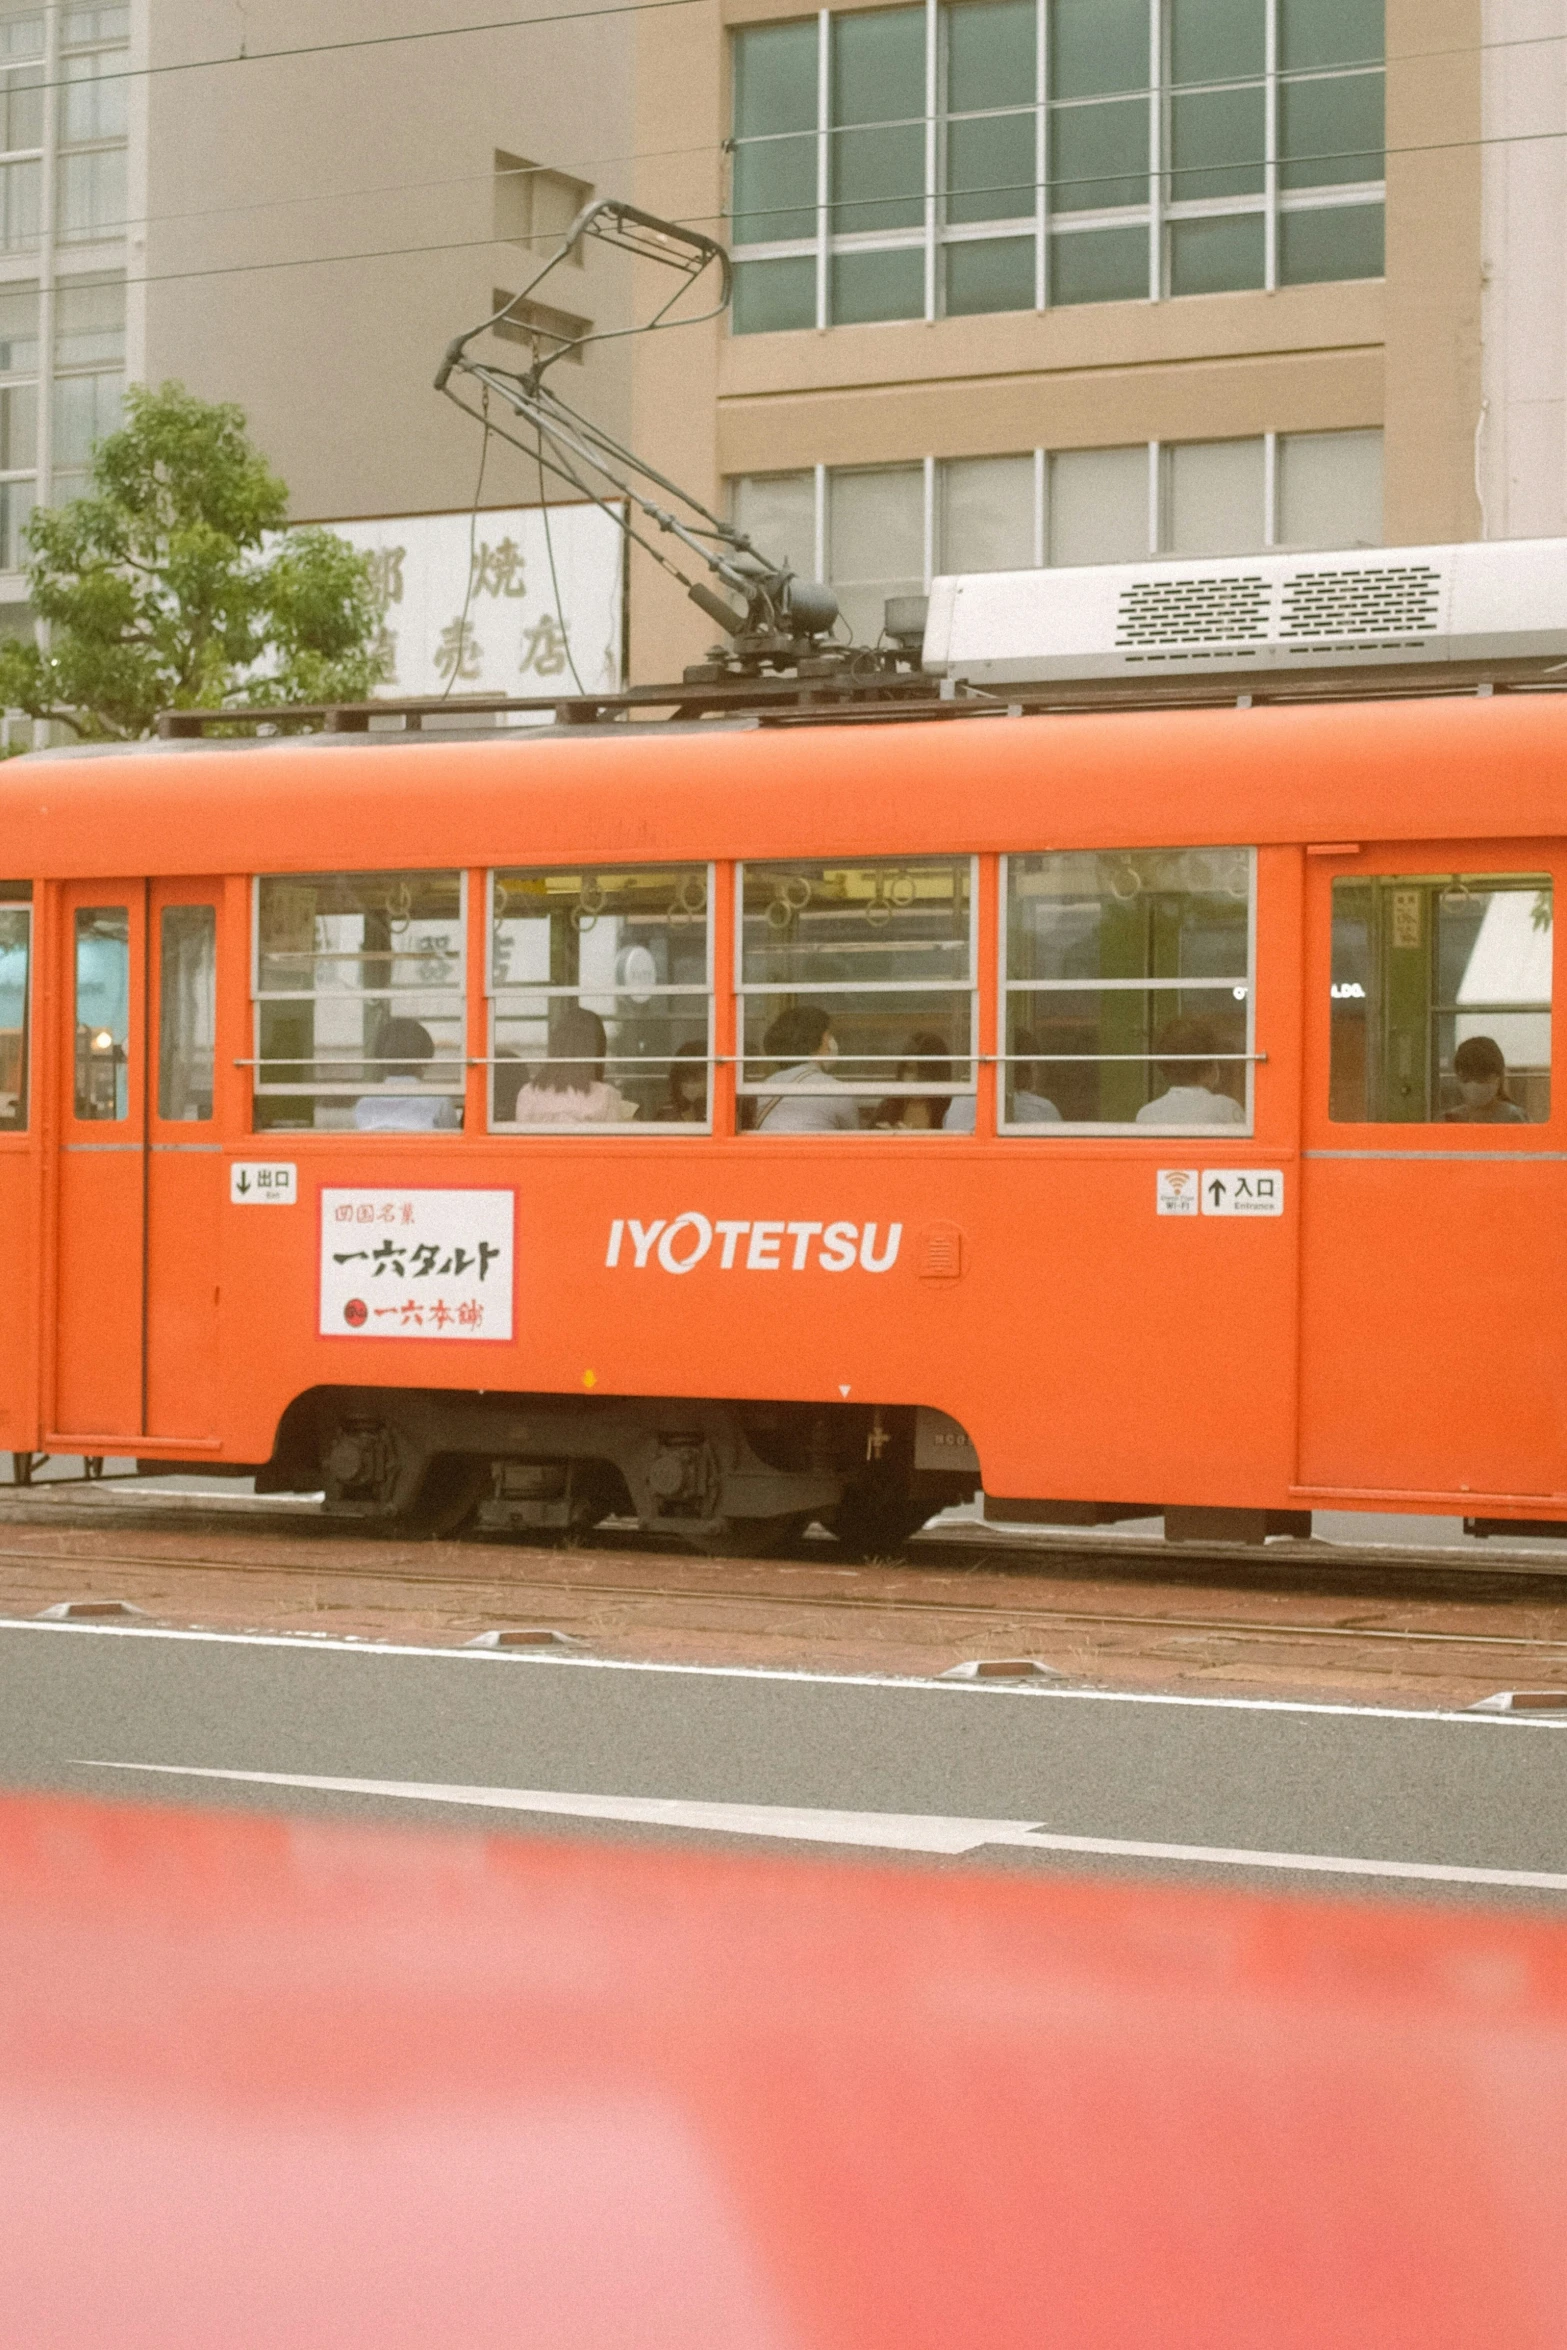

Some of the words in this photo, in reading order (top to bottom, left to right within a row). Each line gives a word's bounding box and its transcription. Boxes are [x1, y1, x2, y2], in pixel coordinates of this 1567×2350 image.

[257, 1170, 289, 1187] 出口
[1235, 1178, 1274, 1197] 入口
[1234, 1202, 1274, 1210] Entrance
[605, 1211, 903, 1274] IYOTETSU
[333, 1240, 498, 1282] 一六タルト
